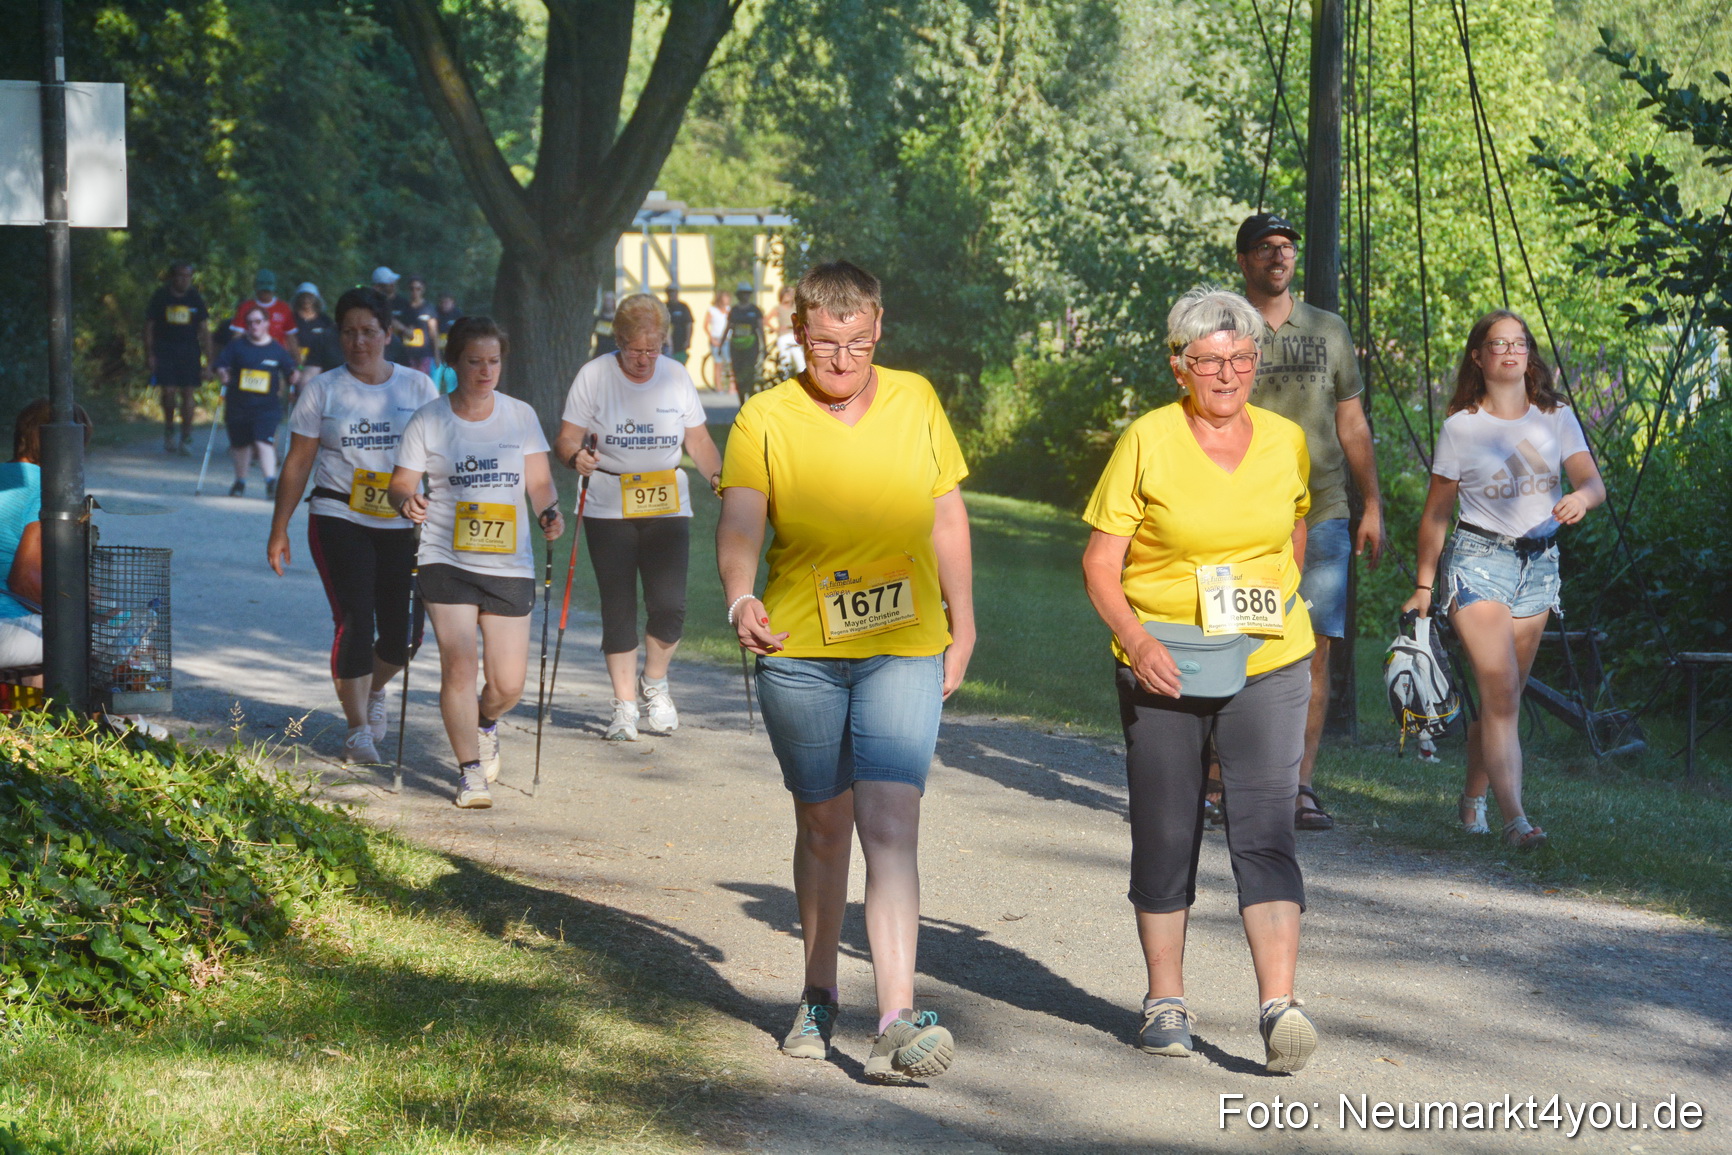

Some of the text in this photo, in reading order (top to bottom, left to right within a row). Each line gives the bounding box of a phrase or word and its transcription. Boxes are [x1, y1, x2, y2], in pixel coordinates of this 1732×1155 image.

[1263, 335, 1326, 345] E-MARK'D
[1260, 343, 1327, 367] LIVER
[1268, 374, 1326, 385] GOODS
[349, 418, 390, 434] KÖNIG
[616, 418, 654, 434] KÖNIG
[341, 434, 402, 448] Engineer
[605, 435, 678, 448] Engineering
[455, 455, 498, 473] KÖNIG
[448, 472, 519, 488] Engineering
[1484, 475, 1558, 499] adidas
[364, 487, 388, 504] 97
[635, 486, 667, 504] 975
[469, 519, 505, 538] 977
[833, 582, 903, 620] 1677
[1213, 588, 1277, 615] 1686
[844, 610, 900, 628] Mayer Christine
[830, 627, 848, 636] Regens
[849, 624, 868, 633] Wagner
